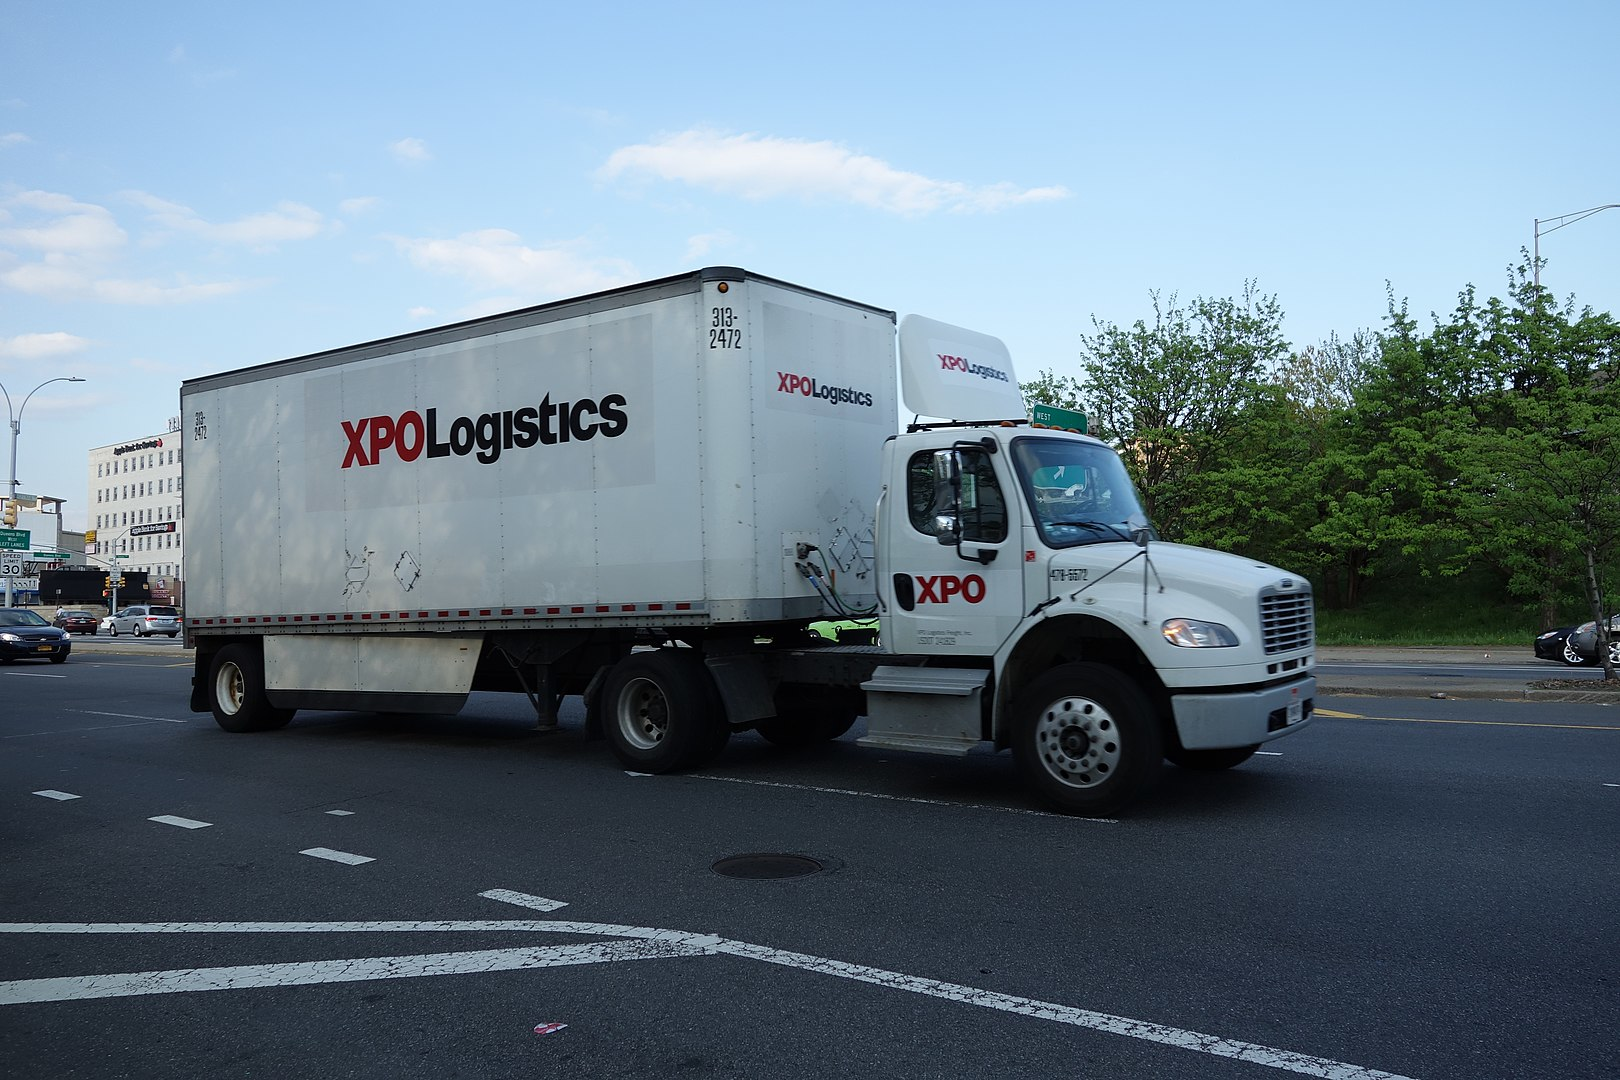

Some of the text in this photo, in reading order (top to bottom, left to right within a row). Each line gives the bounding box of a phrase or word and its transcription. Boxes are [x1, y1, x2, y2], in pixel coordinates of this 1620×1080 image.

[712, 307, 738, 328] 313-
[709, 328, 742, 349] 2472
[1036, 411, 1051, 421] WEST
[194, 425, 208, 441] 2472
[2, 565, 20, 575] 30
[915, 574, 986, 604] XPO
